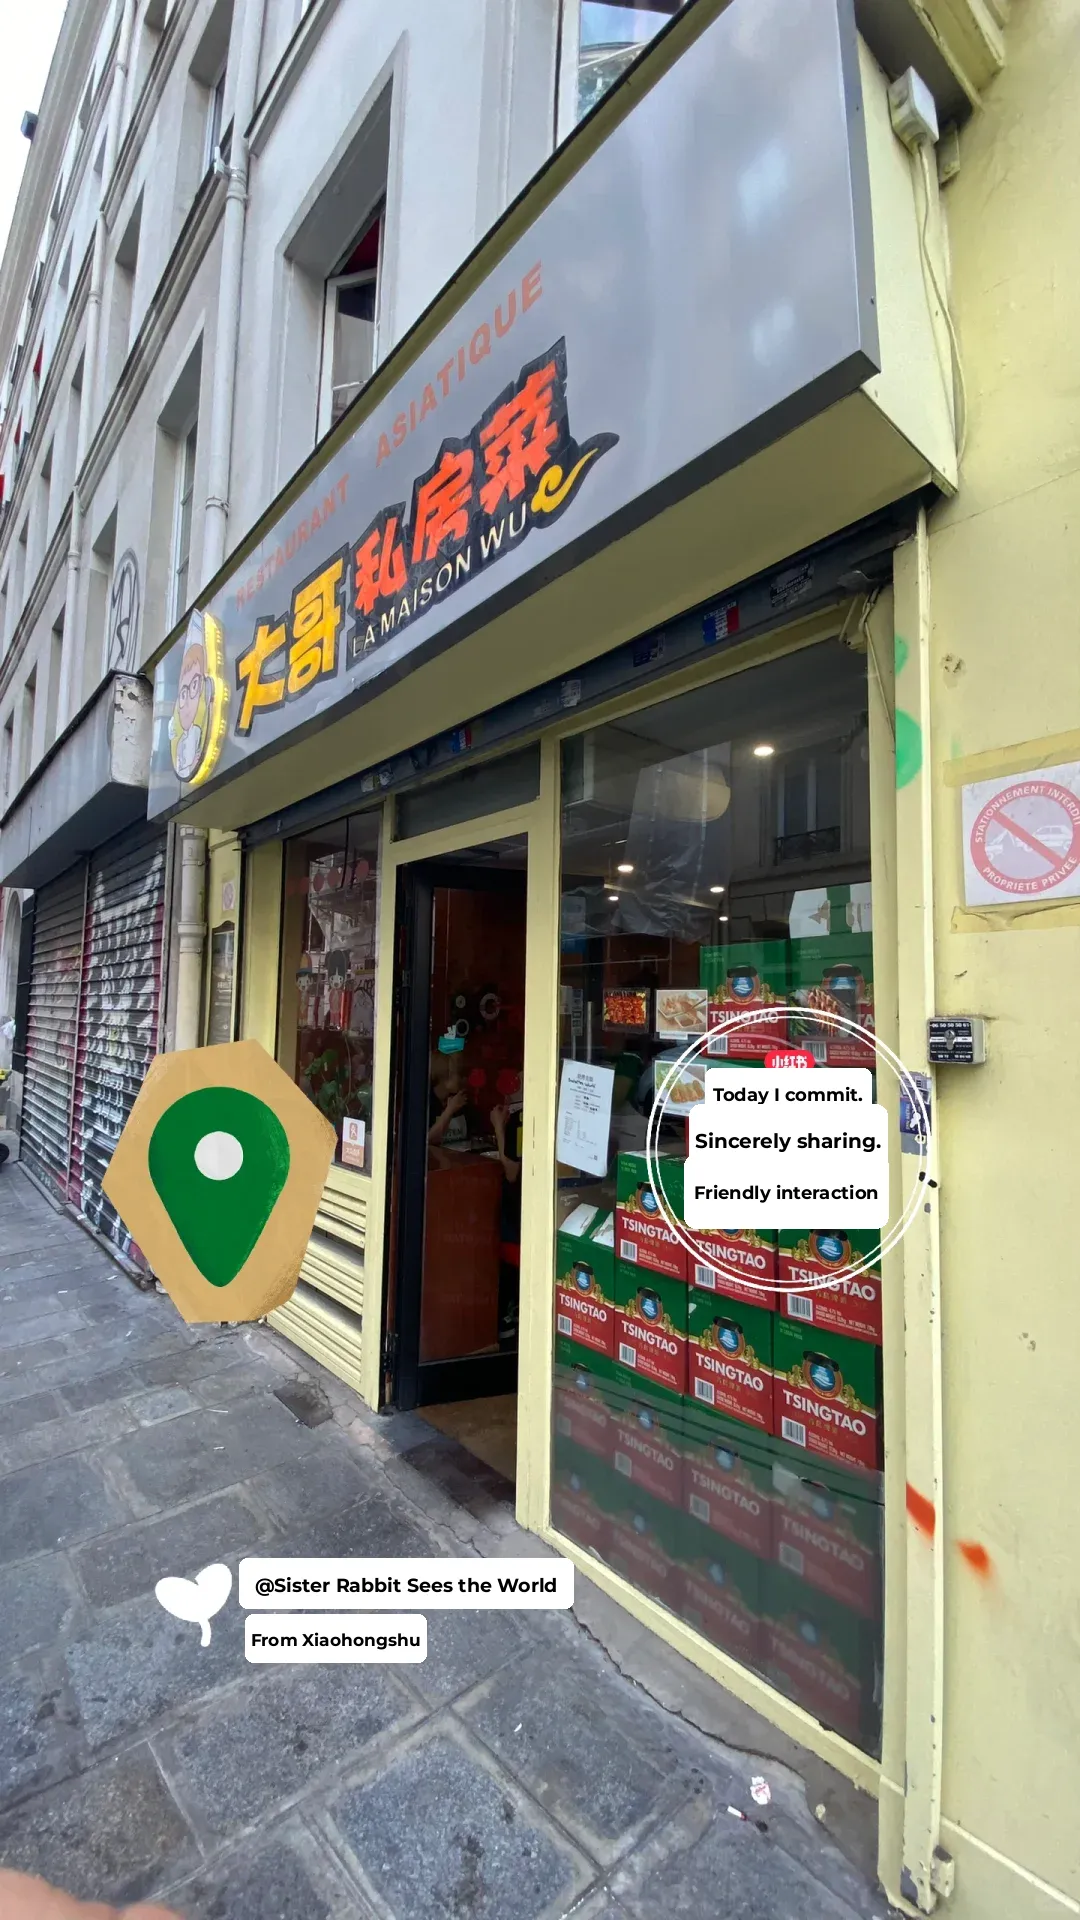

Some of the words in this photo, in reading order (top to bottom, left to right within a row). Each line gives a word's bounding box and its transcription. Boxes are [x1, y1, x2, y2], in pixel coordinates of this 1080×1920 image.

[236, 472, 349, 611] RESTAURANT
[376, 259, 543, 468] ASIATIQUE
[352, 625, 375, 657] LA
[380, 546, 471, 636] MAISON
[480, 501, 527, 558] WU
[975, 785, 1045, 843] STATIONNEMENT
[983, 867, 1038, 891] PROPRIETE
[1042, 856, 1077, 887] PRIVEE
[622, 1216, 680, 1245] TSINGTAO
[696, 1239, 766, 1269] TSINGTAO
[788, 1266, 876, 1301] TSINGTAO
[559, 1293, 608, 1322] TSINGTAO
[621, 1320, 678, 1355] TSINGTAO
[695, 1352, 764, 1391] TSINGTAO
[783, 1389, 866, 1436] TSINGTAO
[617, 1428, 674, 1471] TSINGTAO
[691, 1469, 760, 1516] TSINGTAO
[782, 1514, 864, 1571] TSINGTAO
